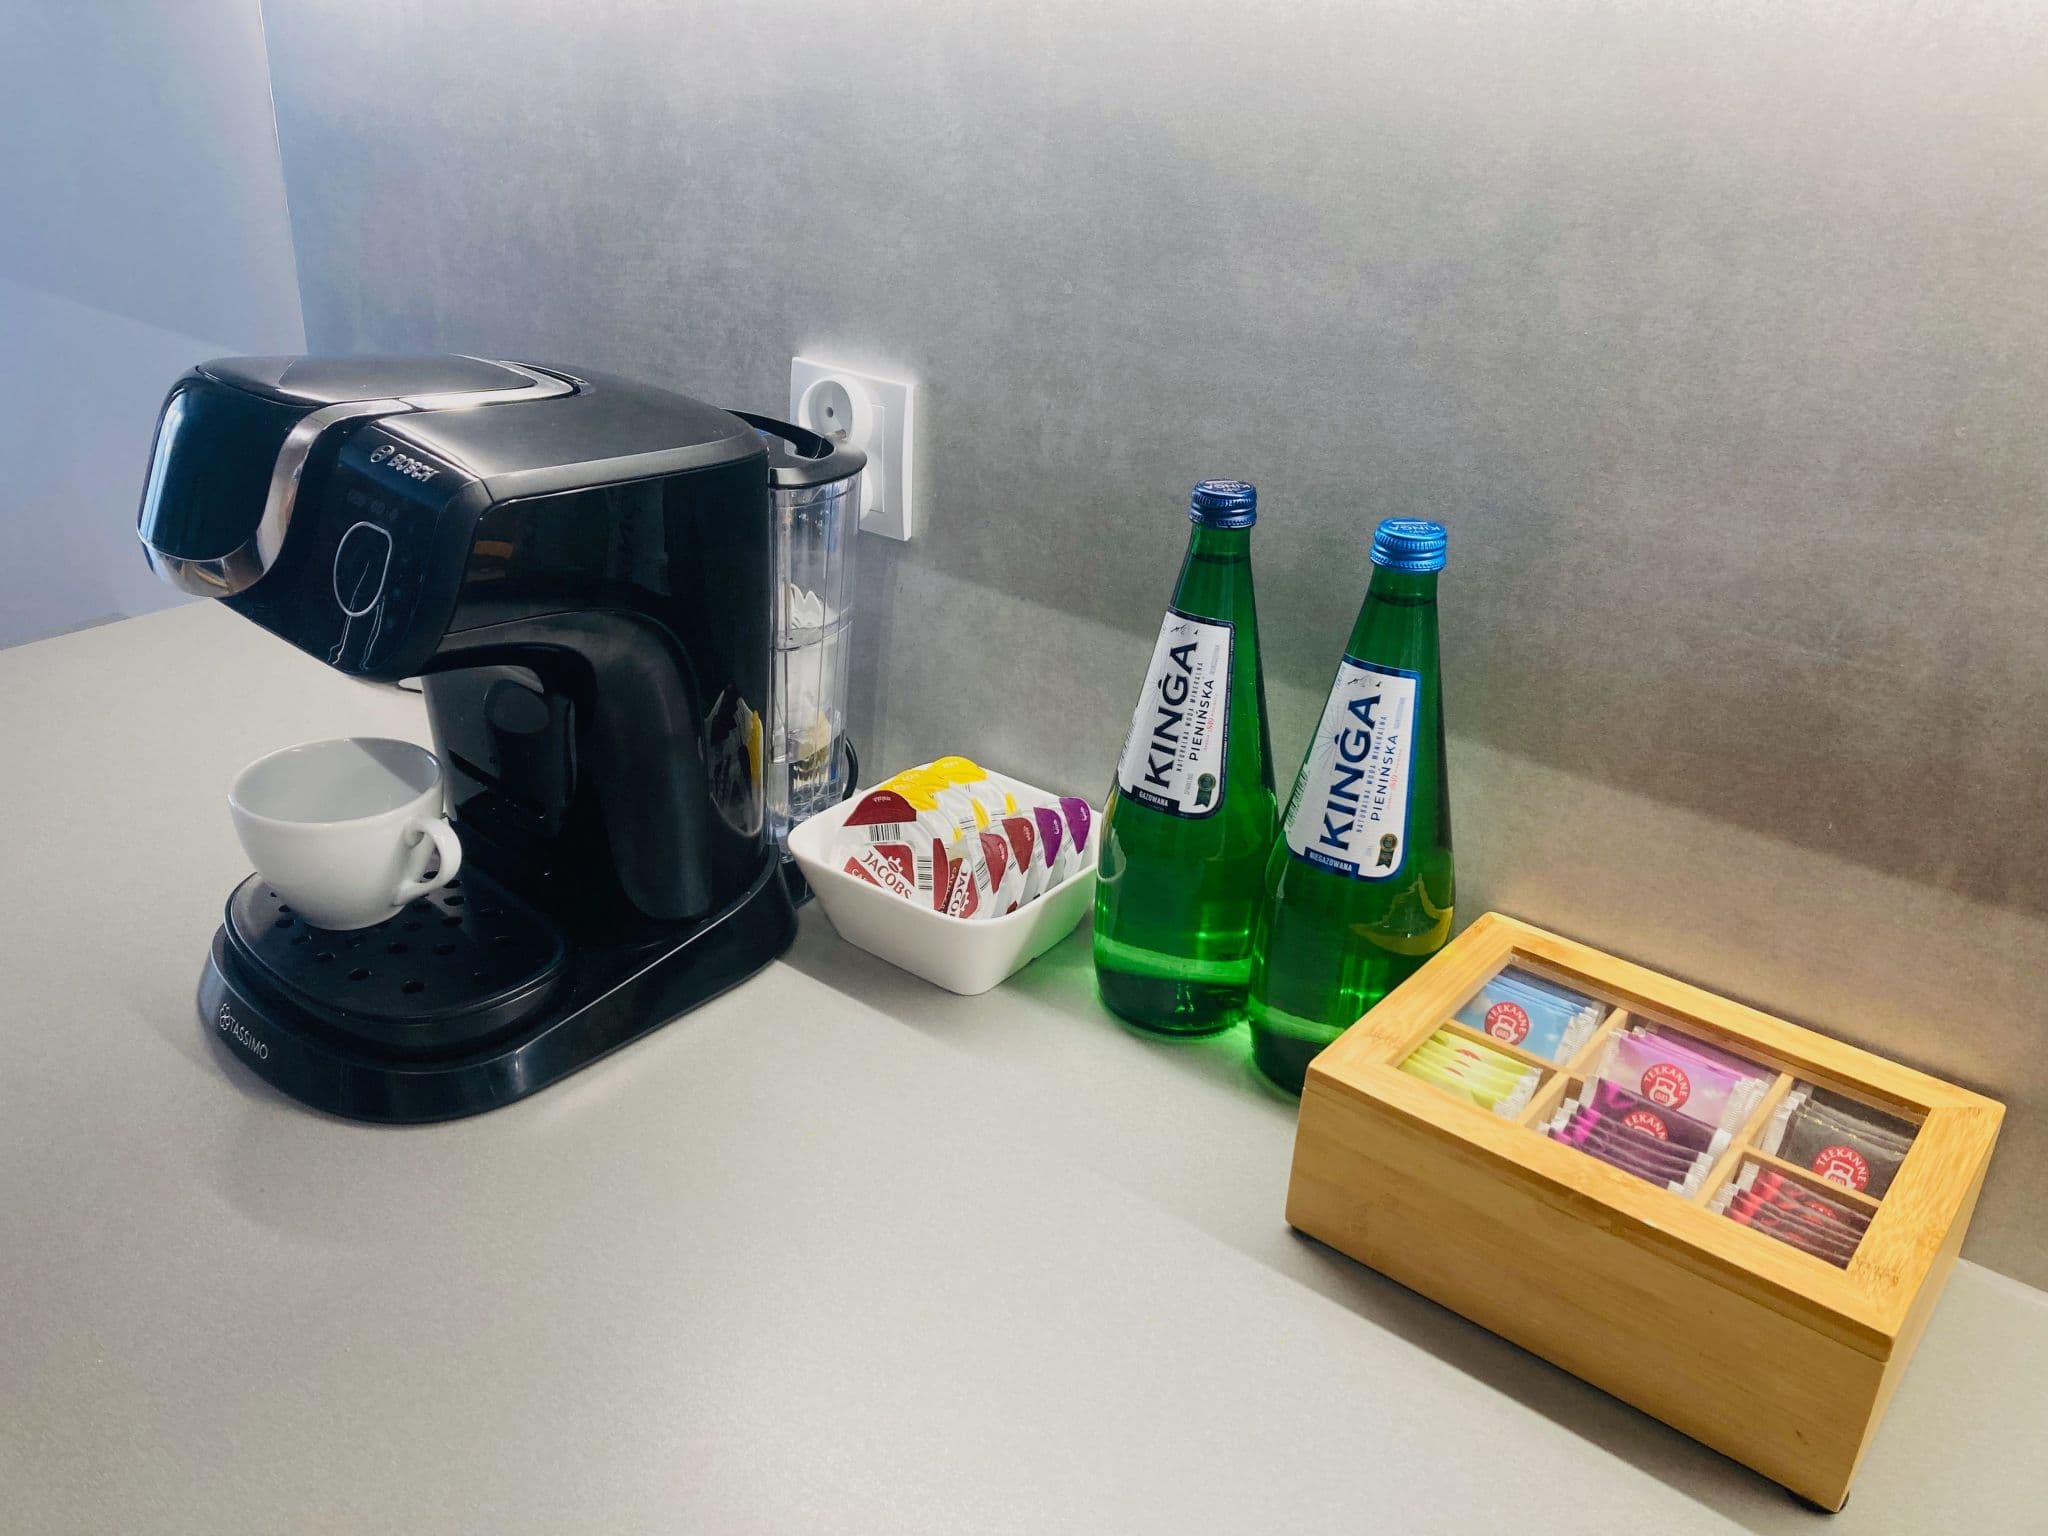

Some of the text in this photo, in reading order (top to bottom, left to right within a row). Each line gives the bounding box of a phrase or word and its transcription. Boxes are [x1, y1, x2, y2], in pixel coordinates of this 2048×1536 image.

[387, 453, 440, 482] BOSCH
[1144, 642, 1198, 789] KINGA
[1189, 680, 1215, 761] PIENIŃSKA
[1319, 694, 1382, 851] KINGA
[1370, 735, 1398, 822] PIENIŃSKA
[861, 851, 911, 899] JACOBS
[950, 871, 968, 917] JACO
[230, 1016, 268, 1059] TASSIMO
[1487, 1004, 1527, 1032] TEEKANNE
[1644, 1066, 1688, 1097] TEEKANNE
[1816, 1148, 1867, 1183] TEEKANNE
